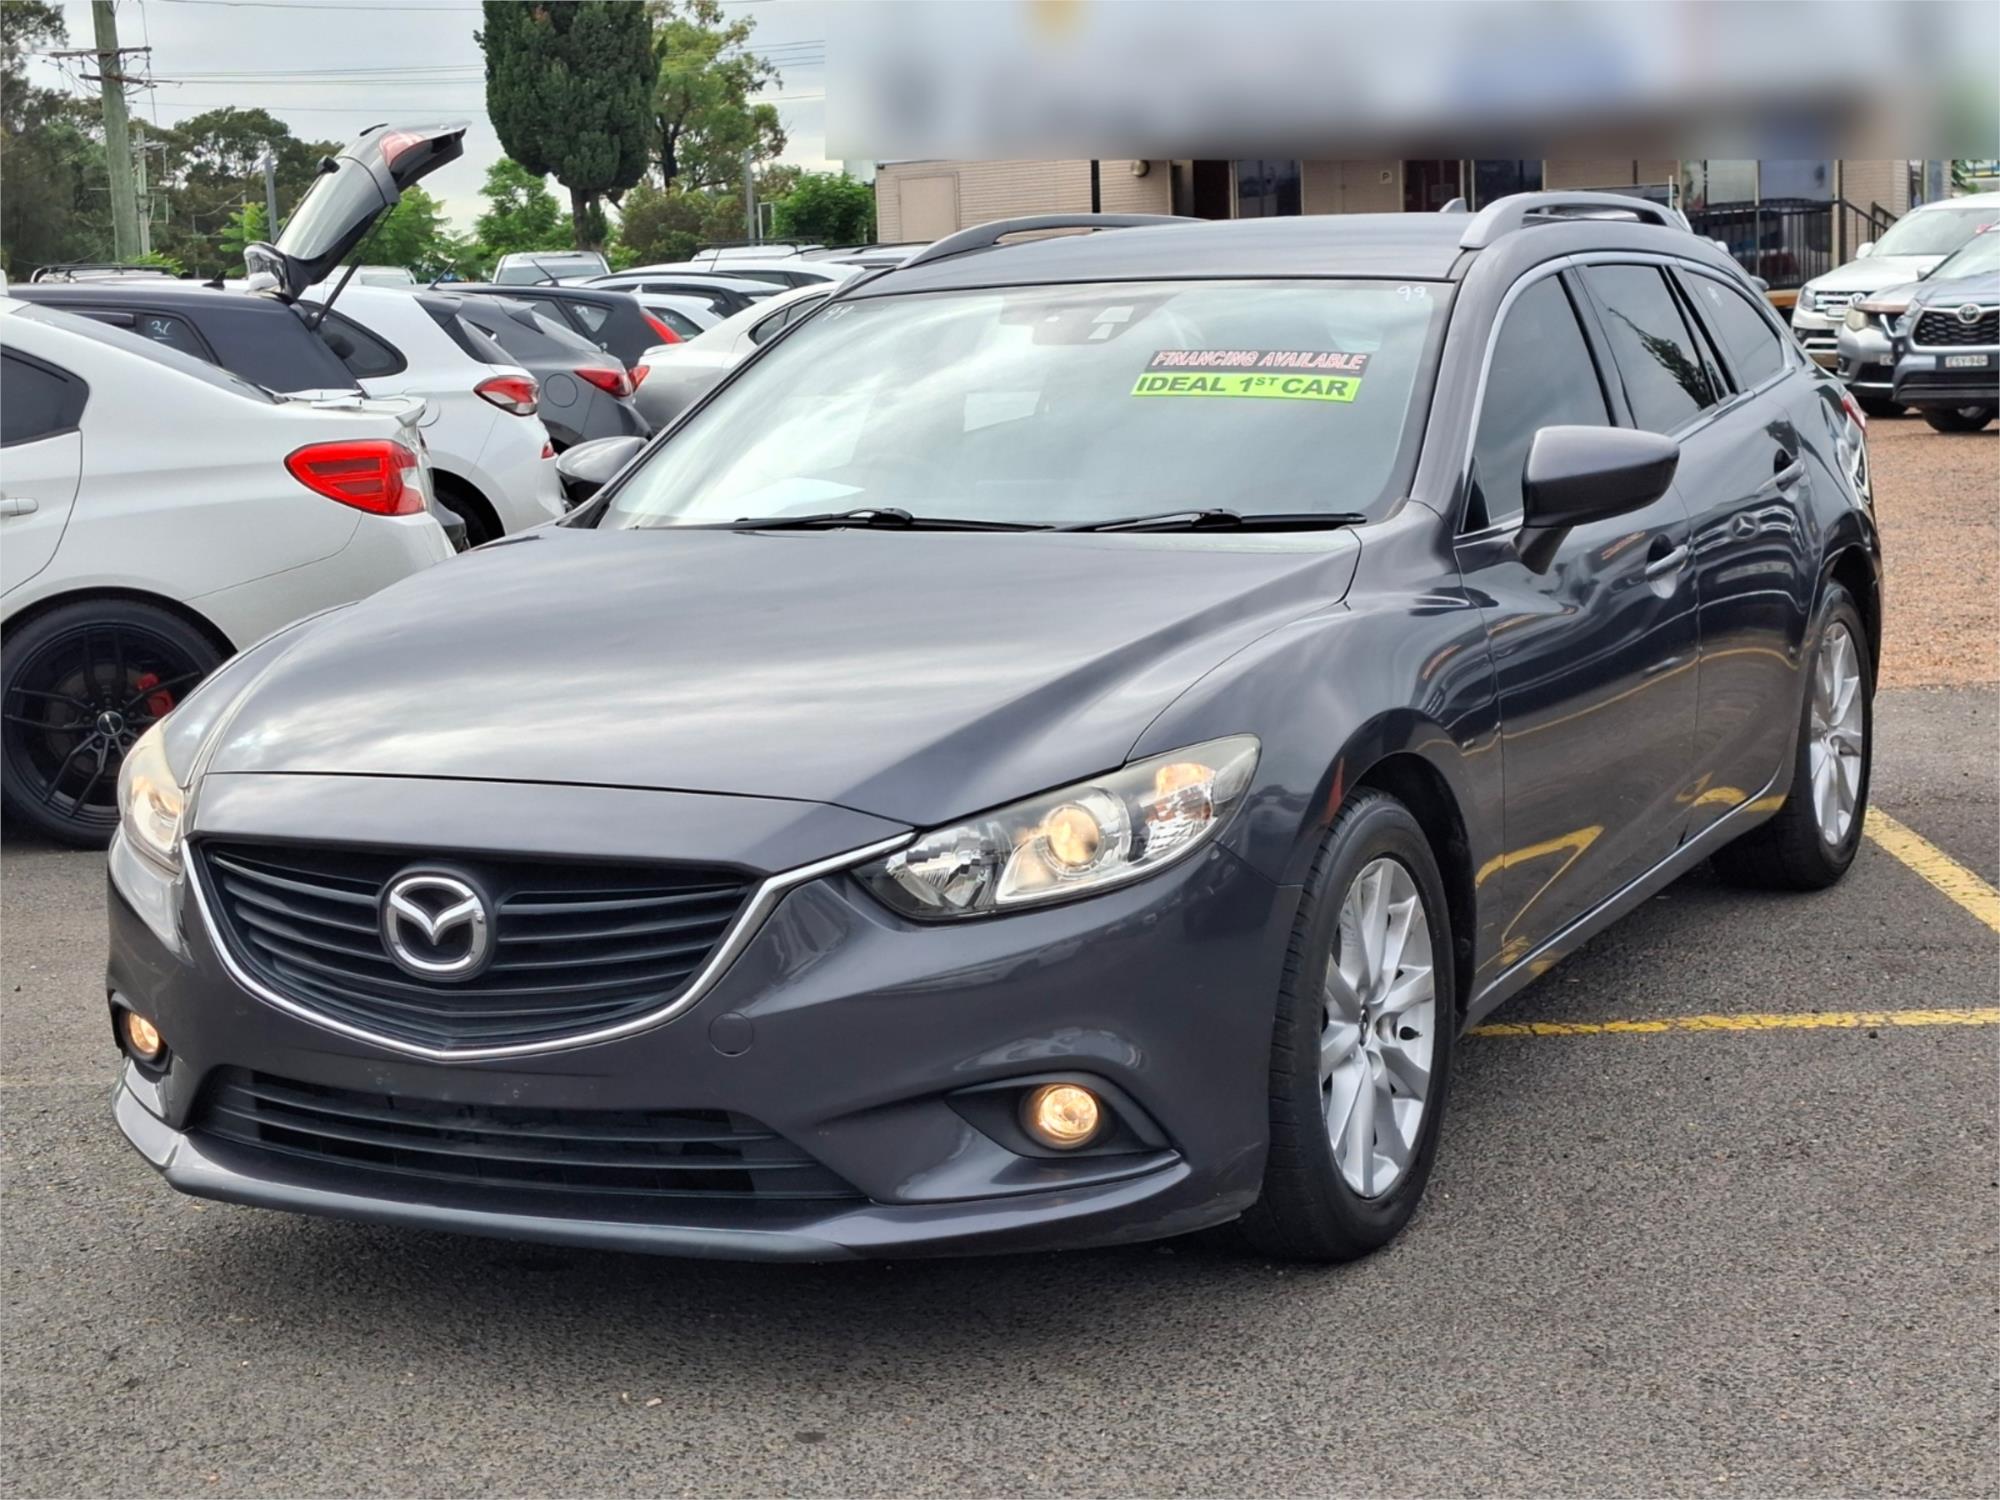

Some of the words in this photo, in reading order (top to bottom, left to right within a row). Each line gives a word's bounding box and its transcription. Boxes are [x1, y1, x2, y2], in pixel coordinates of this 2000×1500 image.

[1151, 350, 1259, 367] FINANCING
[1258, 351, 1368, 370] AVAILABLE
[1136, 376, 1226, 392] IDEAL
[1281, 378, 1349, 396] CAR
